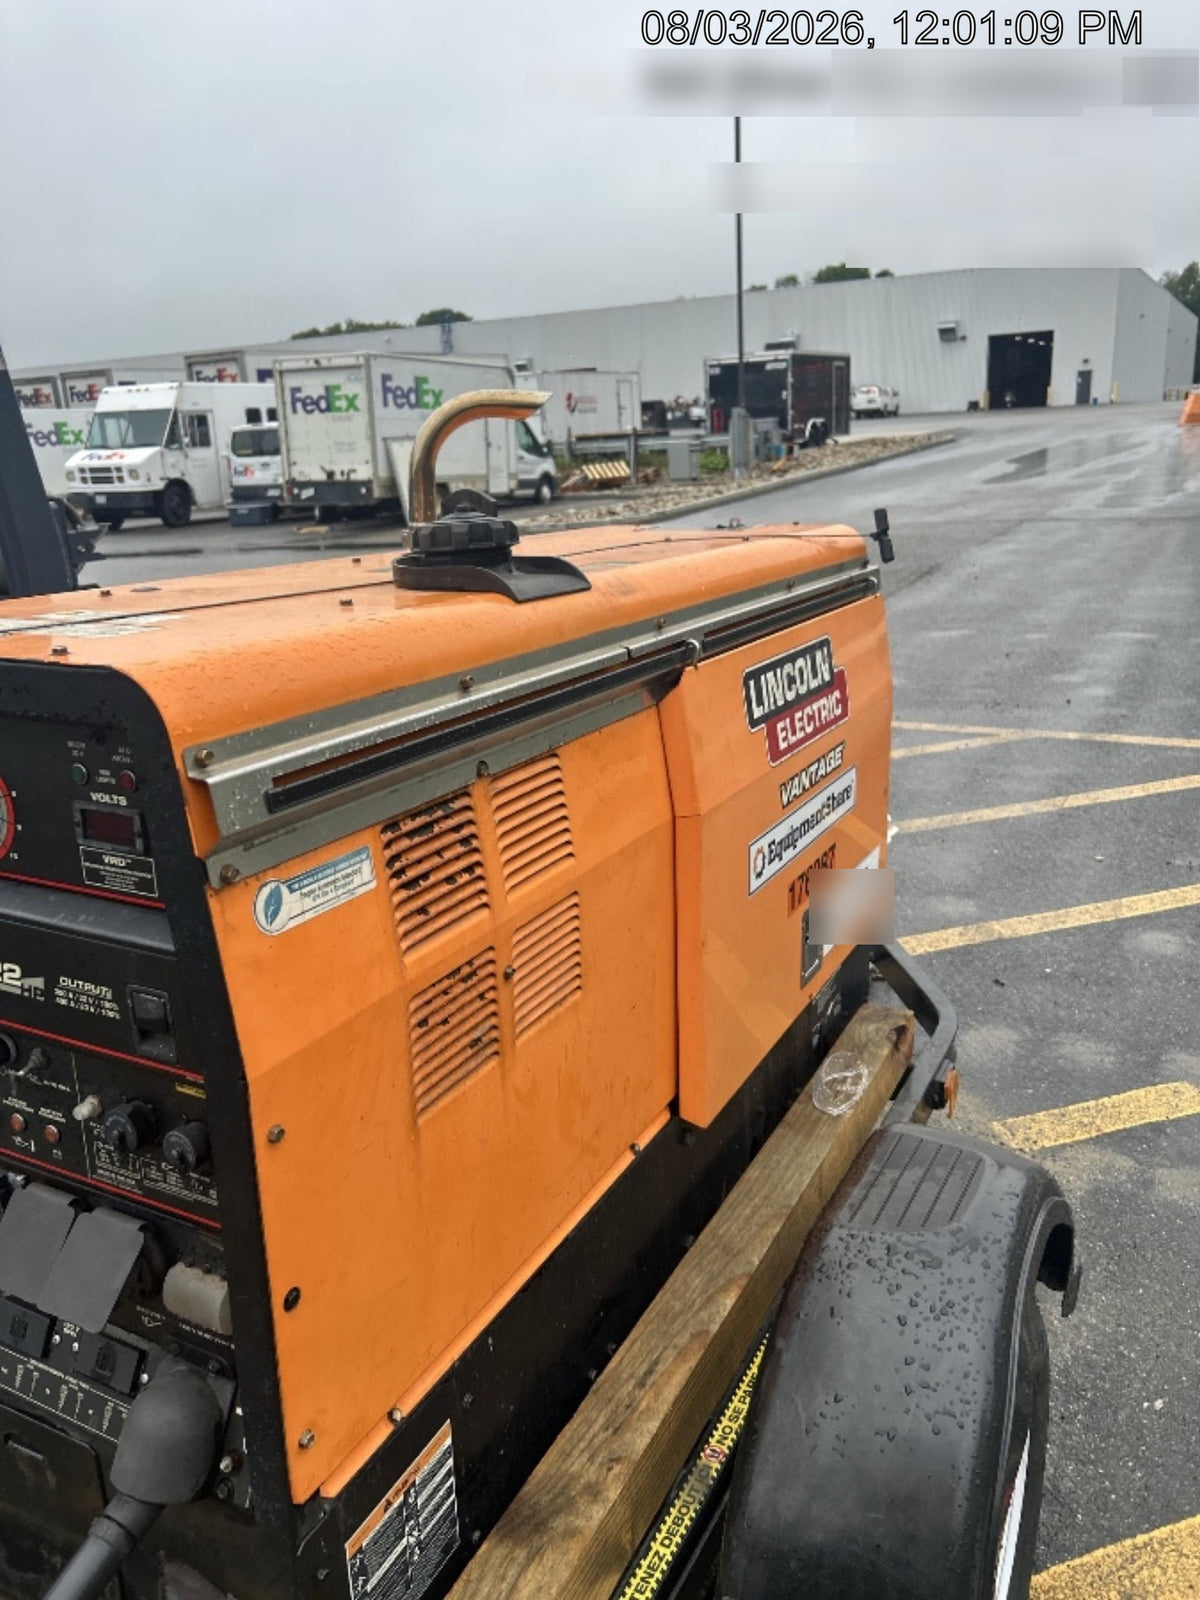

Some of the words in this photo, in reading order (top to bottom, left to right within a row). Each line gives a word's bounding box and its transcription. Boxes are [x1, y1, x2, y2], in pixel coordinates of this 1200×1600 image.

[290, 384, 361, 414] FedEx
[382, 373, 443, 409] FedEx
[749, 646, 831, 719] LINCOLN
[776, 689, 842, 751] ELECTRIC
[90, 791, 128, 807] VOLTS
[779, 743, 844, 809] VANTAGE
[767, 785, 853, 866] EquipmentShare
[59, 975, 112, 1000] OUTPUT
[715, 1425, 734, 1446] NO
[728, 1405, 745, 1423] SE
[658, 1484, 705, 1549] DEBOUT
